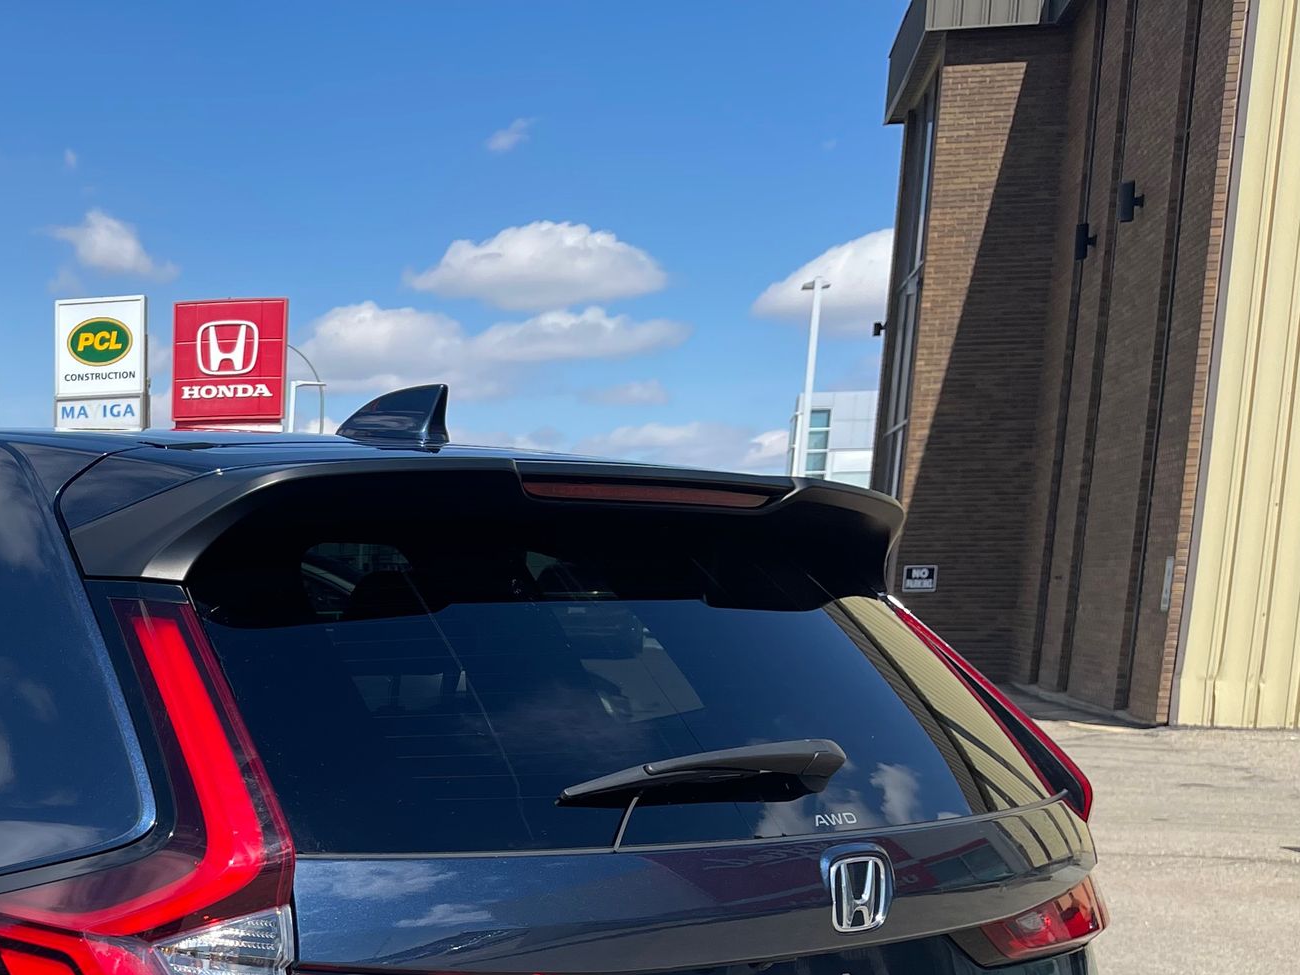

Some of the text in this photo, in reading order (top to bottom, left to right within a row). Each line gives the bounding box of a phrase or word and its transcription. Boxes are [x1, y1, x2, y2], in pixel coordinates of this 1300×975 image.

[77, 330, 123, 352] PCL
[64, 370, 136, 382] CONSTRUCTION
[181, 383, 273, 400] HONDA
[912, 568, 929, 579] NO
[815, 812, 857, 827] AWD
